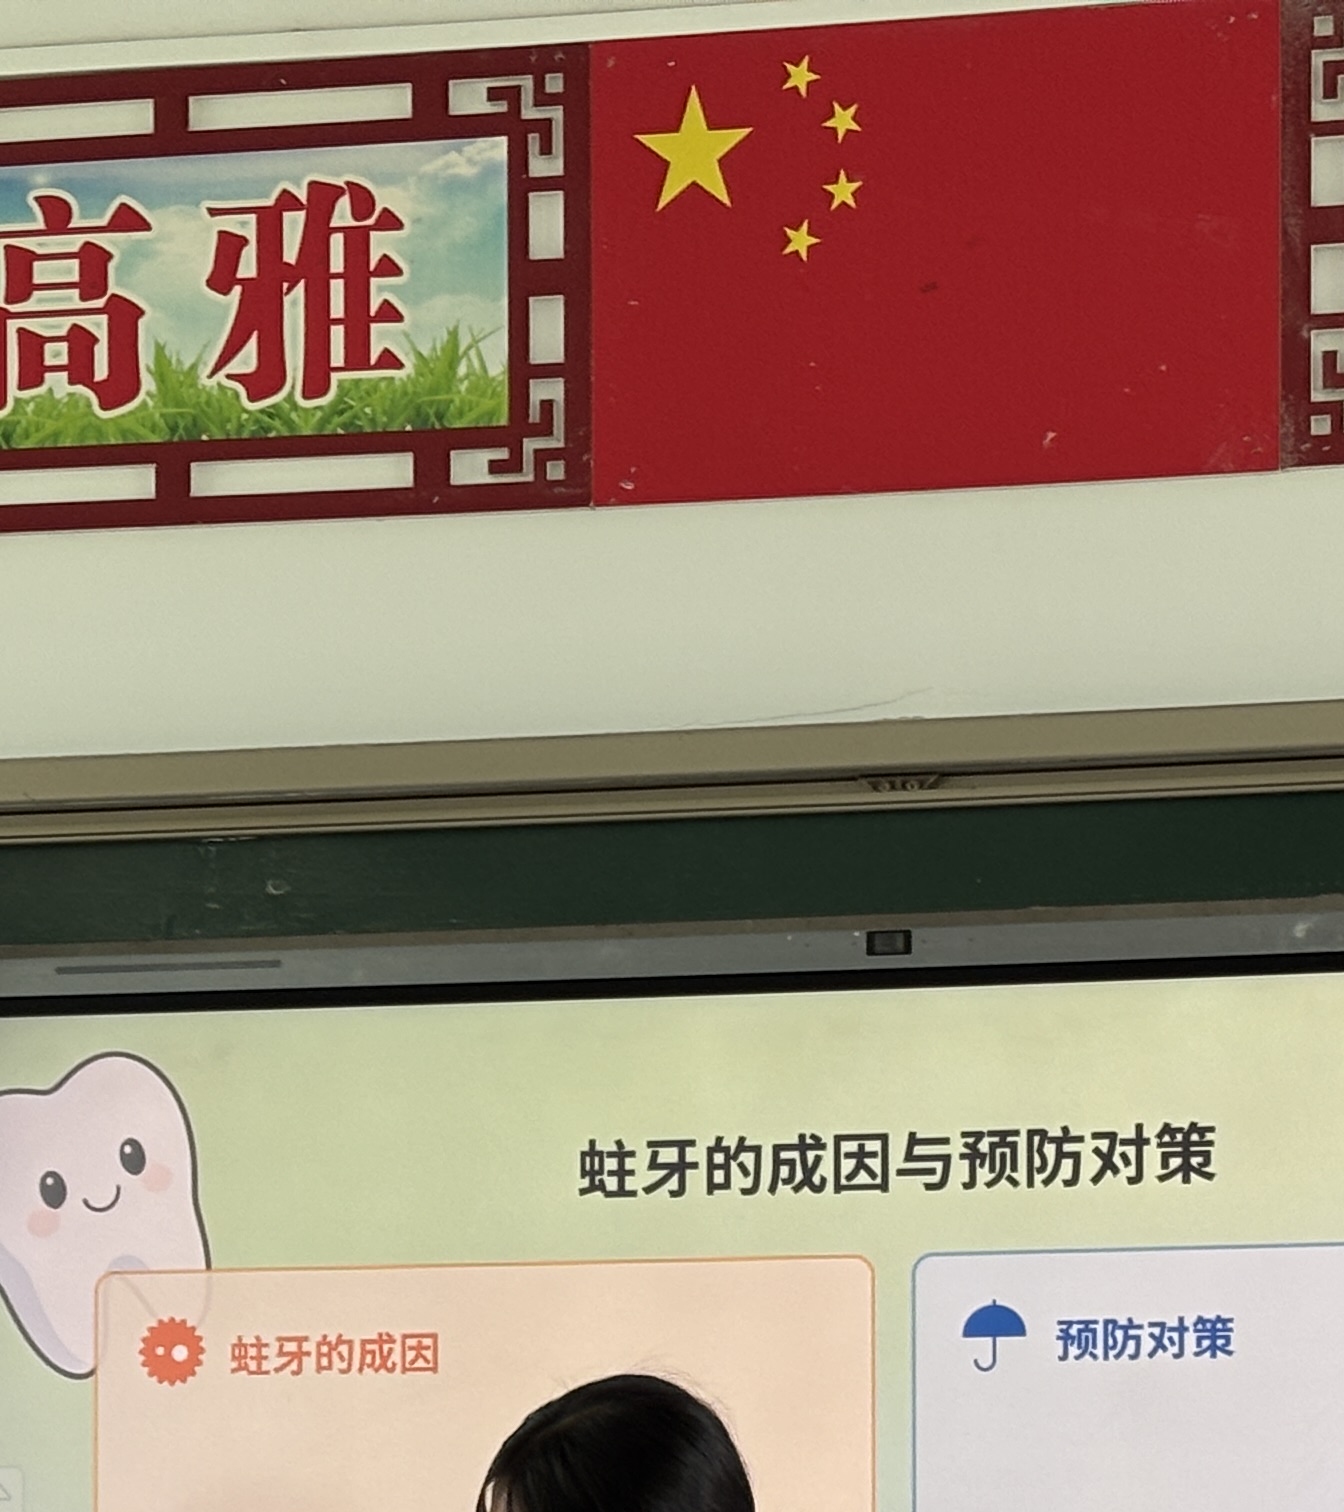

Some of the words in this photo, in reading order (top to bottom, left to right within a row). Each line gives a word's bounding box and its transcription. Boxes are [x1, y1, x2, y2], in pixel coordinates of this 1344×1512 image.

[577, 1121, 1219, 1199] 蛀牙的成因与预防对策
[229, 1331, 440, 1377] 蛀牙的成因
[1055, 1313, 1236, 1363] 预防对策
